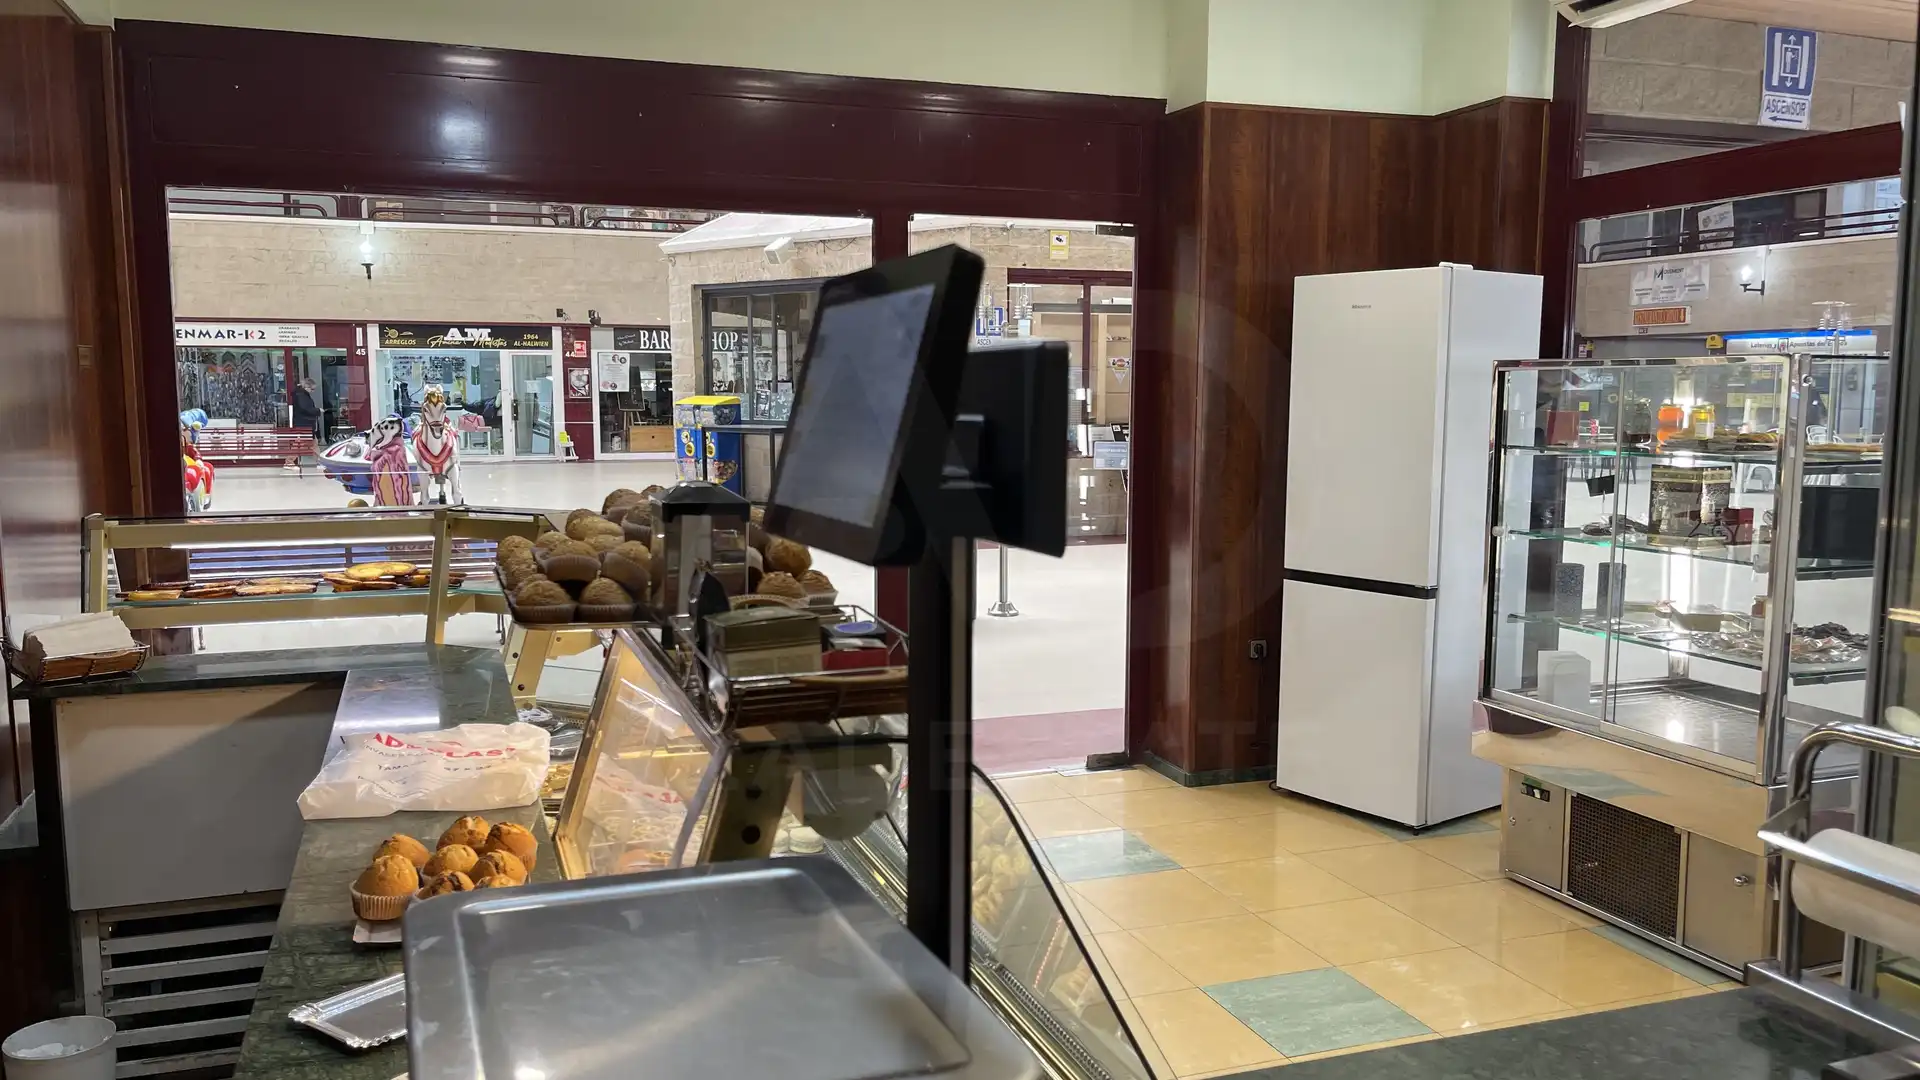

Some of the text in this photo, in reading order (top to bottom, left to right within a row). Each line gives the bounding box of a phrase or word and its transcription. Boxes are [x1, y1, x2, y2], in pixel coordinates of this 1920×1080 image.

[1764, 98, 1806, 117] ASCENSOR
[443, 327, 492, 342] AM
[355, 348, 366, 356] 45
